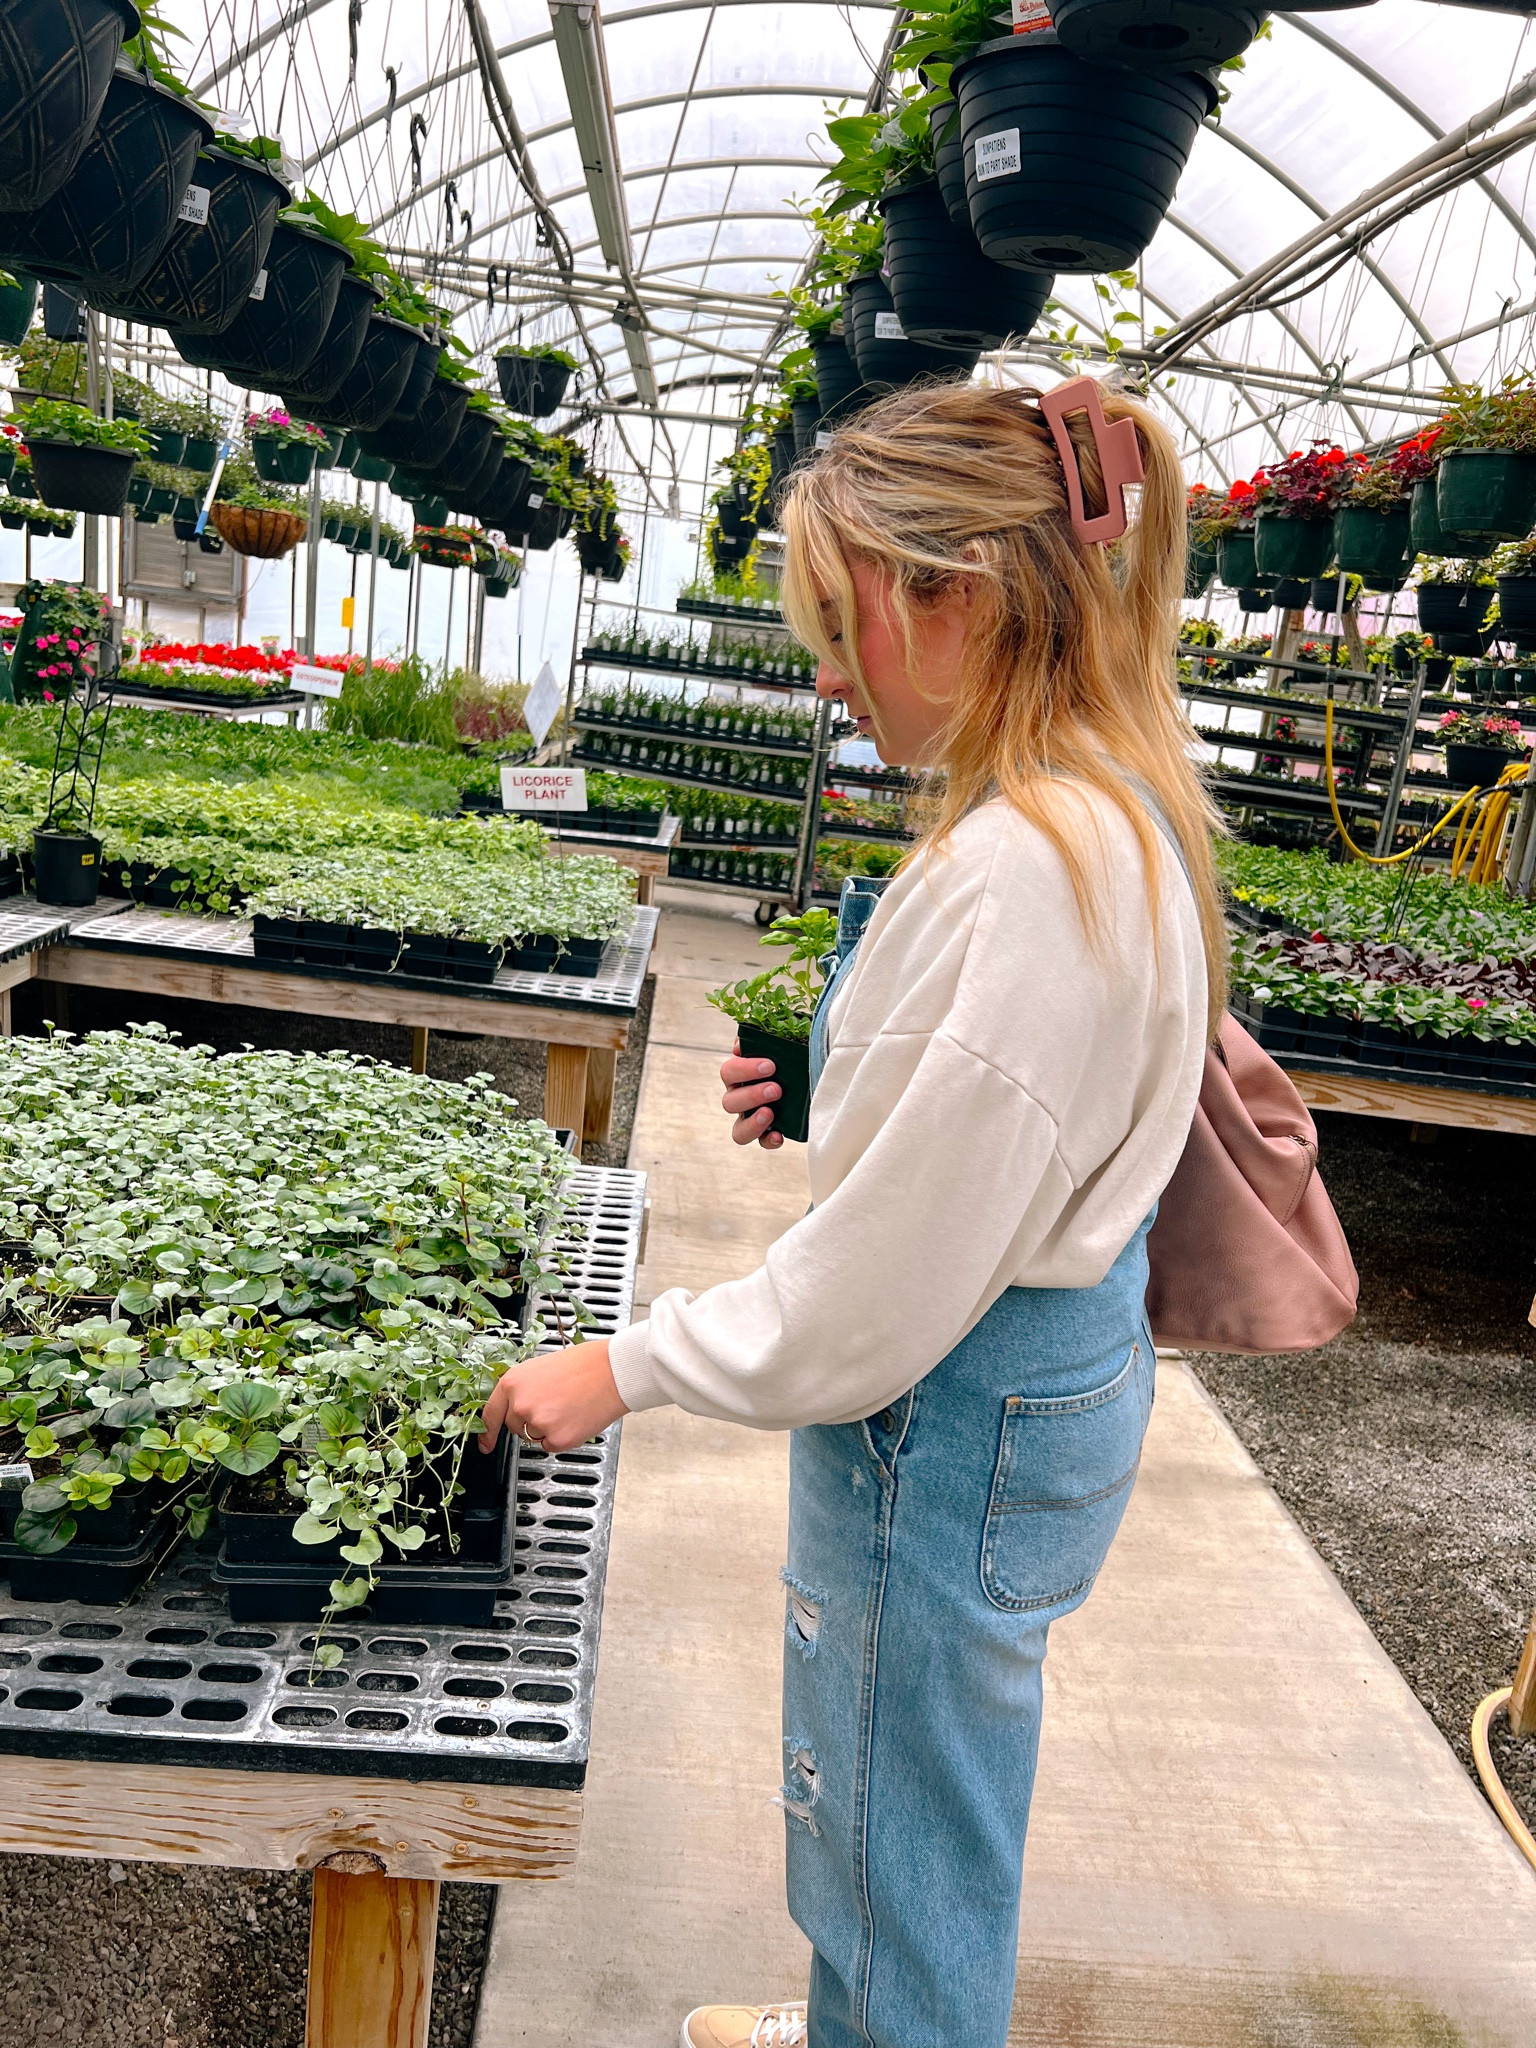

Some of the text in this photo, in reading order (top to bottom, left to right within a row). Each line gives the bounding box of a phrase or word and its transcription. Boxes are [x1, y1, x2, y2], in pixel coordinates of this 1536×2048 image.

[982, 137, 1006, 155] SUNPATIENS
[985, 161, 990, 174] TO
[990, 158, 1001, 172] PART
[1001, 155, 1017, 170] SHADE
[185, 189, 197, 202] ENS
[188, 207, 204, 221] SHADE
[512, 776, 574, 787] LICORICE
[525, 789, 567, 800] PLANT
